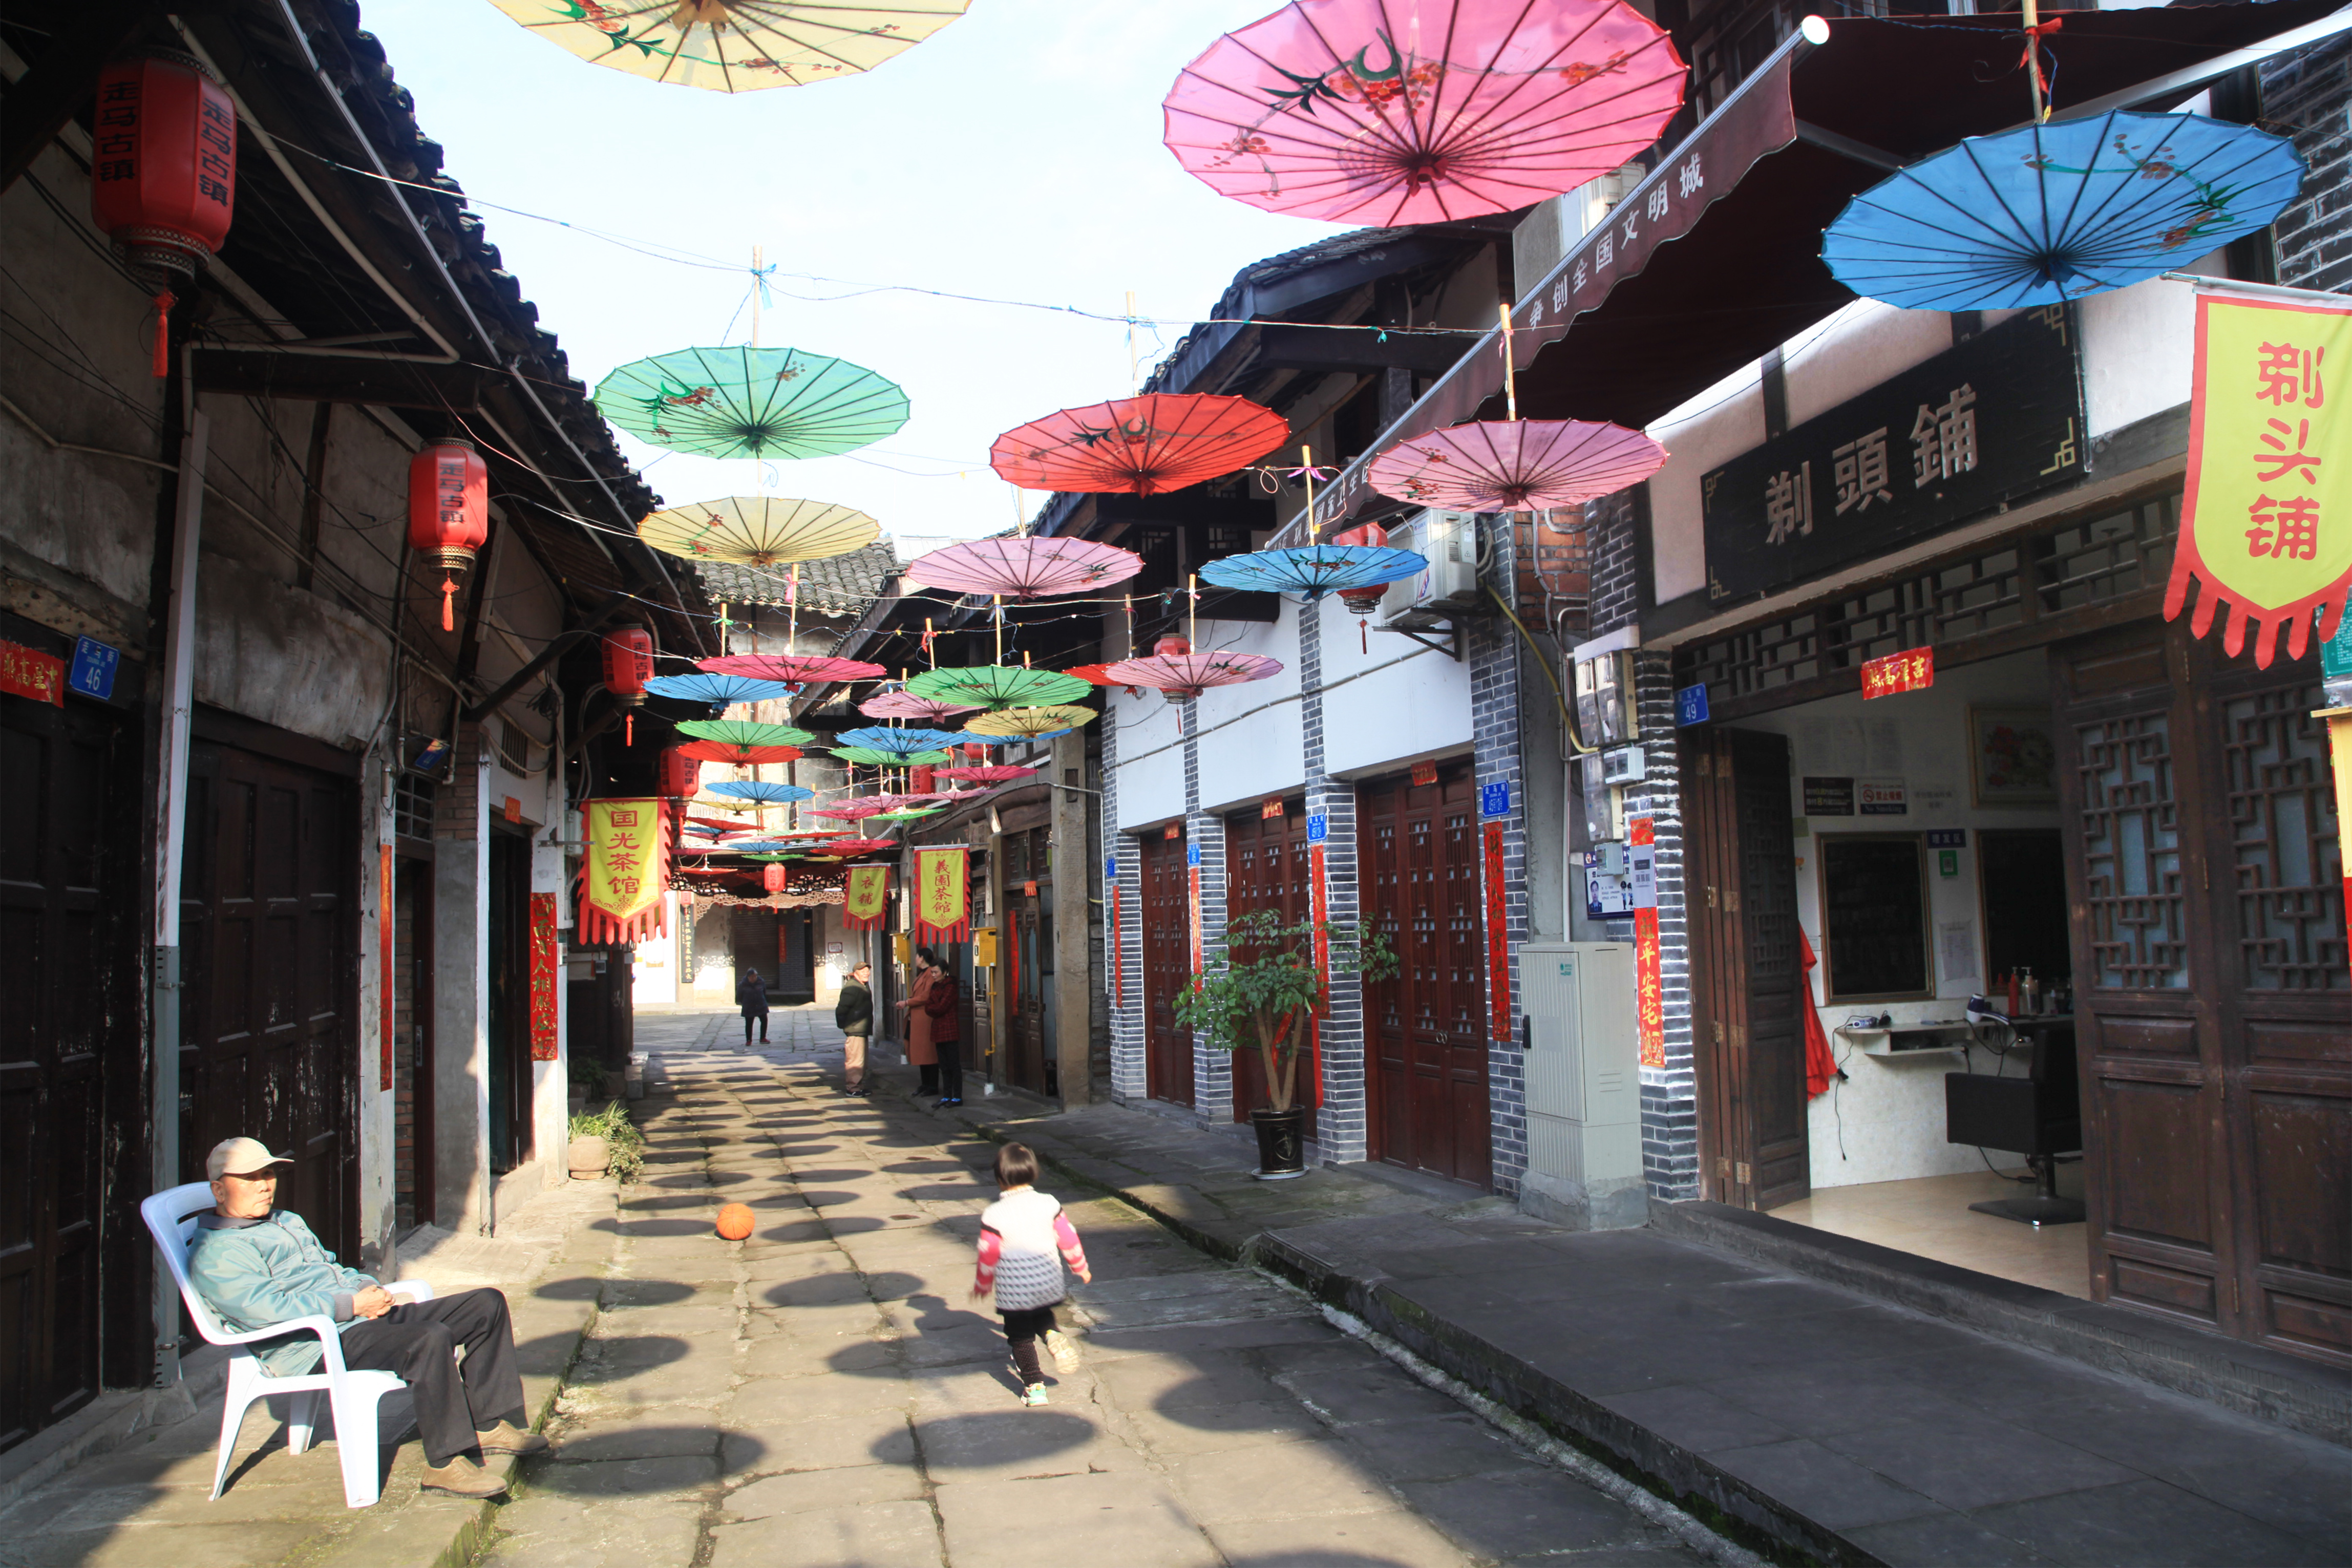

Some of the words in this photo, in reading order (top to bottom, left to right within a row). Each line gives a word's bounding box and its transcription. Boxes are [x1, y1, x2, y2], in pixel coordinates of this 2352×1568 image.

[99, 81, 139, 181] 走马古镇
[199, 97, 232, 207] 走马古镇
[1529, 152, 1704, 331] 争创全国文明城
[1765, 382, 1979, 546] 剃頭鋪
[2244, 341, 2325, 560] 剃头铺
[439, 463, 465, 523] 走马古镇
[82, 641, 115, 664] 走马街
[86, 666, 101, 691] 46
[634, 642, 648, 681] 走马古镇
[1686, 703, 1697, 721] 49
[1876, 791, 1902, 801] 禁止吸烟
[607, 811, 640, 895] 国光茶馆
[931, 860, 952, 914] 義園茶館
